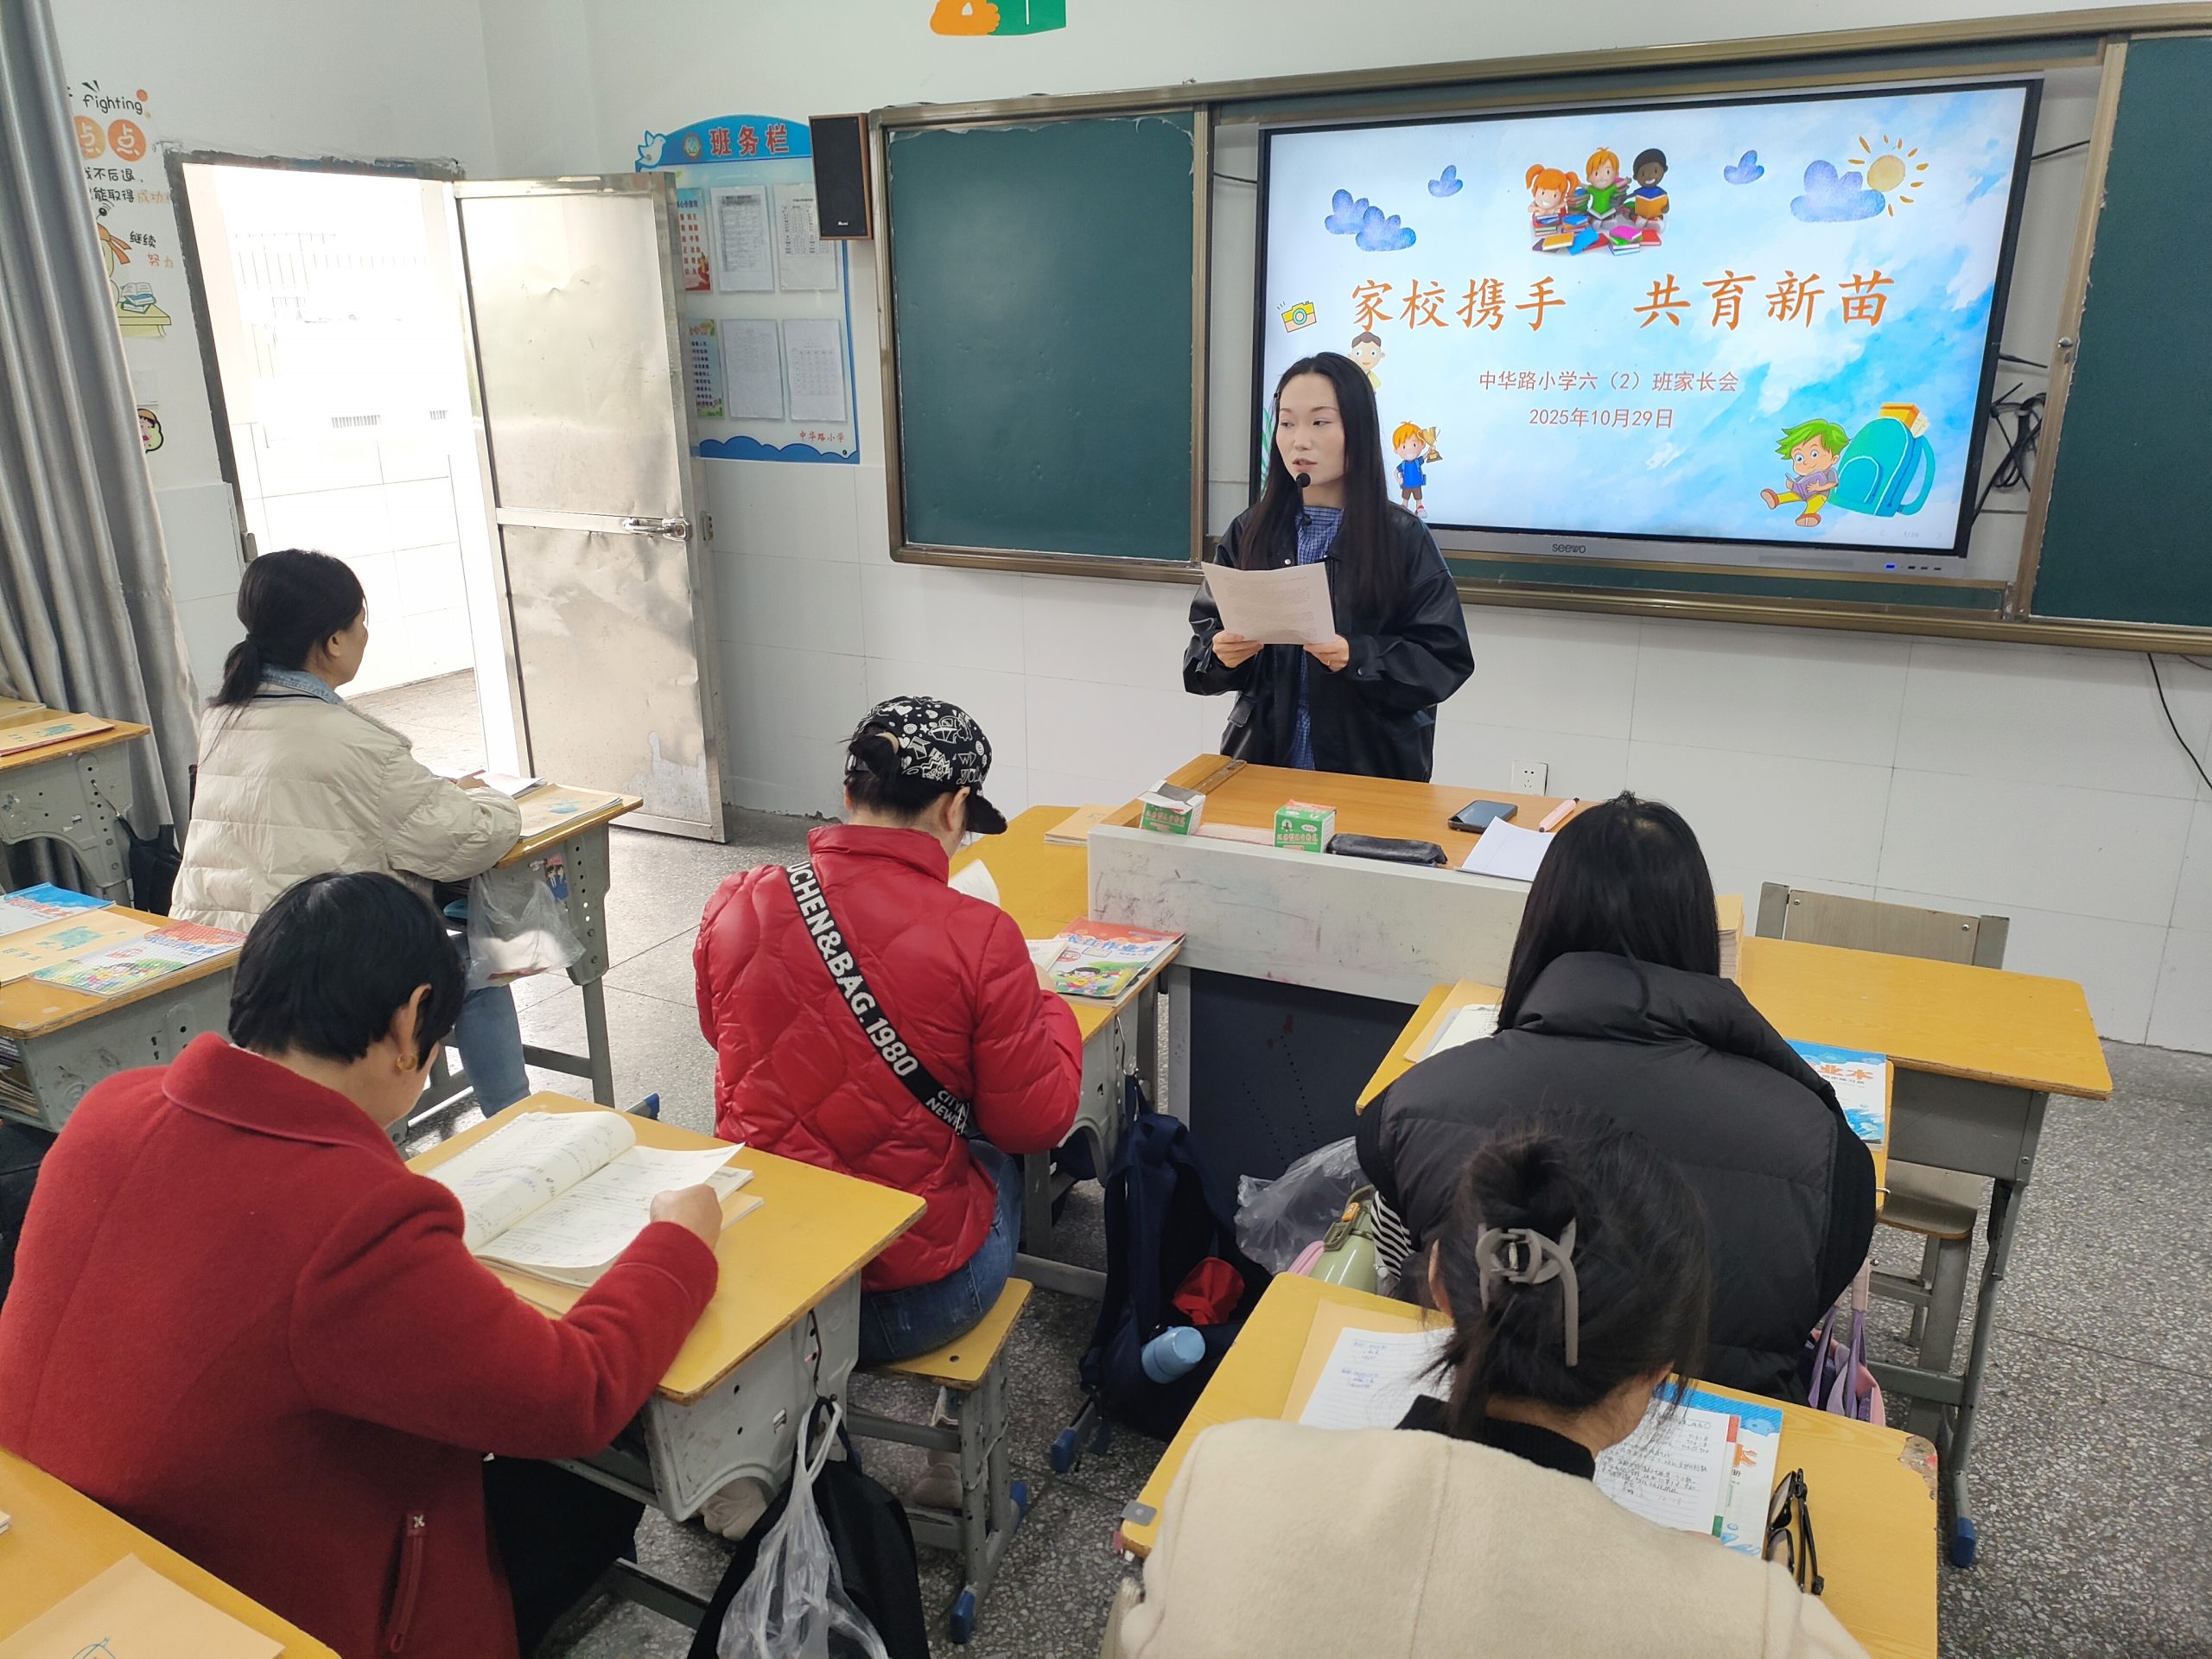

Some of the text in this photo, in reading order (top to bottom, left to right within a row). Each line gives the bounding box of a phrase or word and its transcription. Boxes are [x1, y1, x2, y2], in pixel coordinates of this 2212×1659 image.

[709, 124, 789, 156] 班务栏
[130, 231, 156, 248] 继续
[1350, 270, 1896, 332] 家校携手 共育新苗
[1478, 371, 1738, 392] 中华路小学六（2）班家长会
[1529, 407, 1674, 429] 2025年10月29日
[799, 431, 844, 443] 中华路小学
[1552, 543, 1586, 554] seewo
